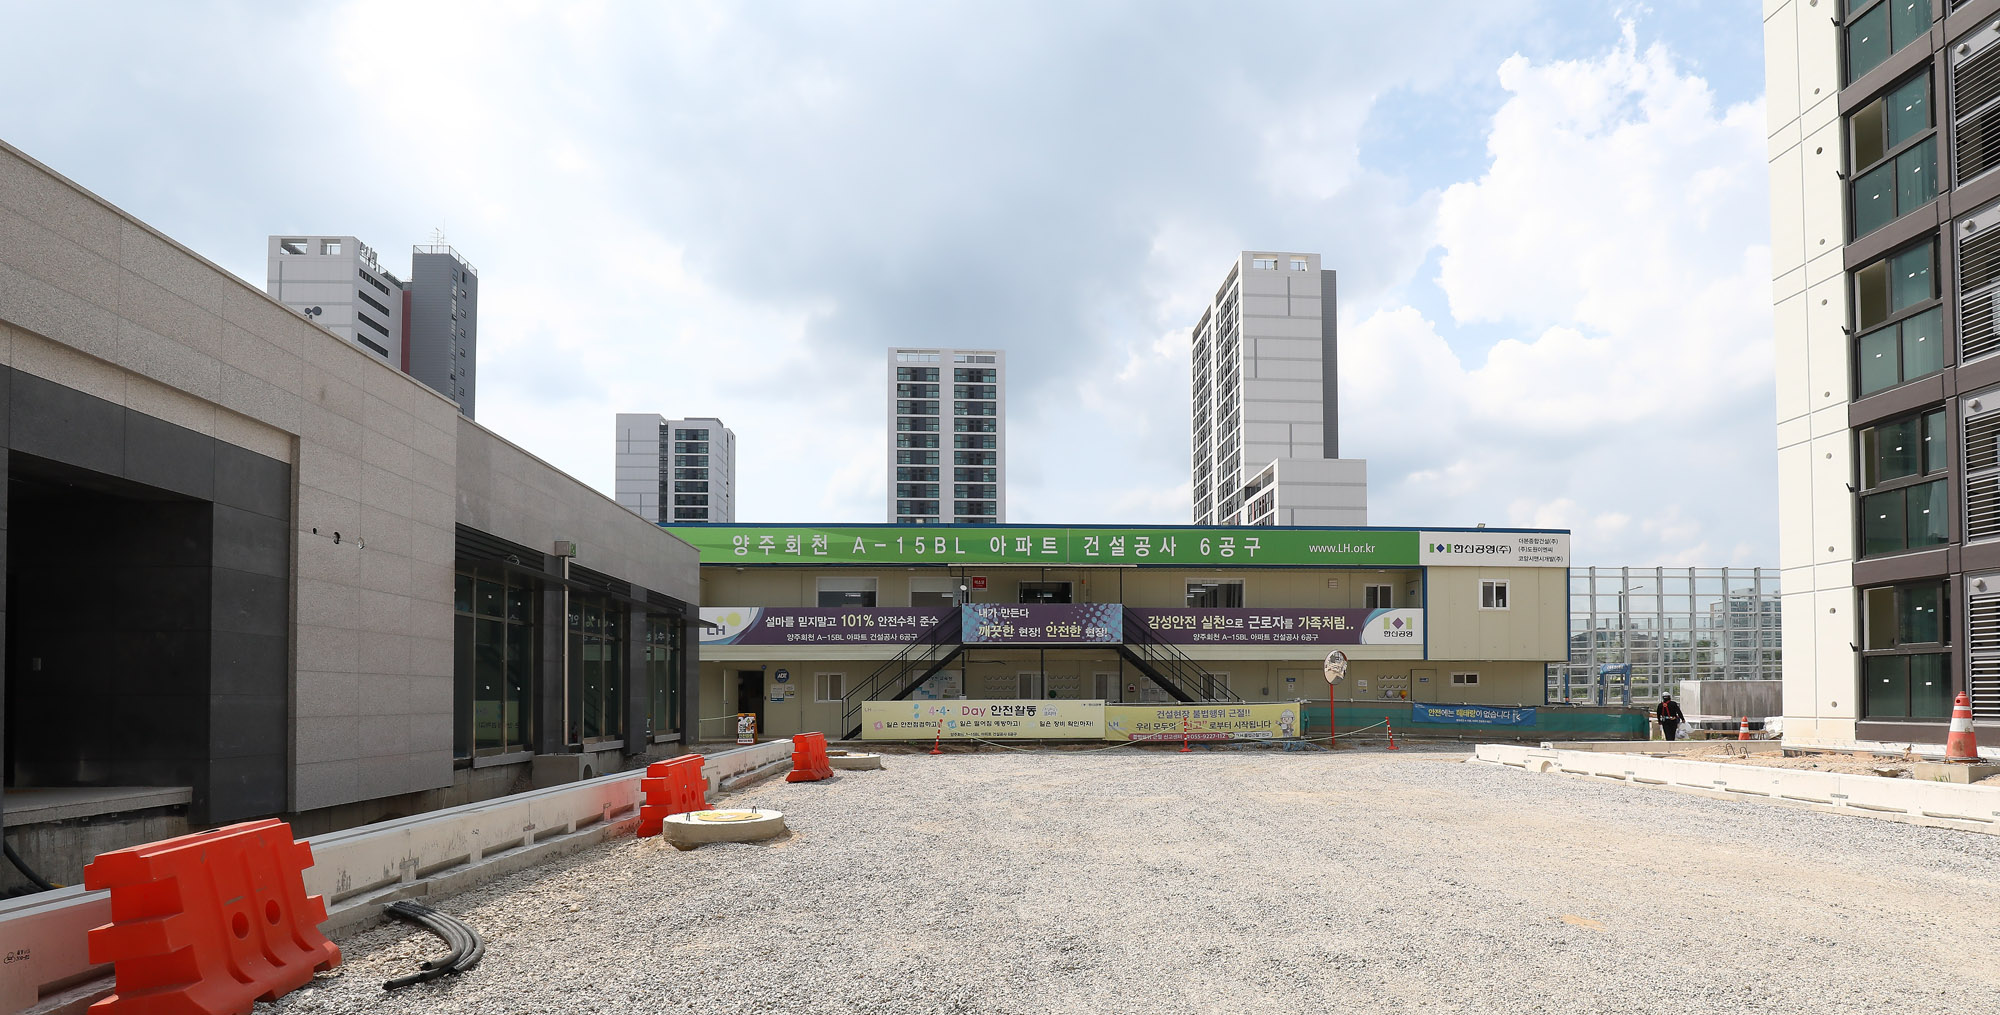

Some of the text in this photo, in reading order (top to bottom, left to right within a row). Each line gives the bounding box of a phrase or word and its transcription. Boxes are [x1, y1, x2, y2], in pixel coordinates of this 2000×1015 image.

[732, 534, 1261, 558] 양주회천 A-15BL 아파트 건설공사 6공구
[1308, 543, 1376, 553] www.LH.or.kr
[1453, 543, 1512, 554] 한신공영(주)
[978, 608, 1030, 618] 내가 만든다
[765, 614, 939, 628] 설마를 믿지말고 101% 안전수칙 준수
[1147, 615, 1354, 630] 감성안전 실천으로 근로자를 가족처럼..
[706, 625, 726, 636] LH
[978, 624, 1108, 638] 깨끗한 현장! 안전한 현장!
[1383, 630, 1413, 638] 한신공영
[786, 633, 815, 642] 양주회천
[846, 633, 867, 641] 아파트
[869, 633, 898, 641] 건설공사
[1192, 633, 1220, 641] 양주회천
[1250, 633, 1270, 641] 아파트
[1272, 633, 1300, 641] 건설공사
[1300, 633, 1319, 641] 6공구
[961, 705, 987, 717] Day
[990, 705, 1037, 717] 안전활동
[1157, 708, 1250, 719] 건설현장 불법행위 근절!!
[1483, 710, 1511, 719] 없습니다
[1136, 722, 1151, 731] 우리
[1153, 722, 1177, 731] 모두의
[1208, 721, 1232, 729] 로부터
[1233, 720, 1272, 729] 시작됩니다
